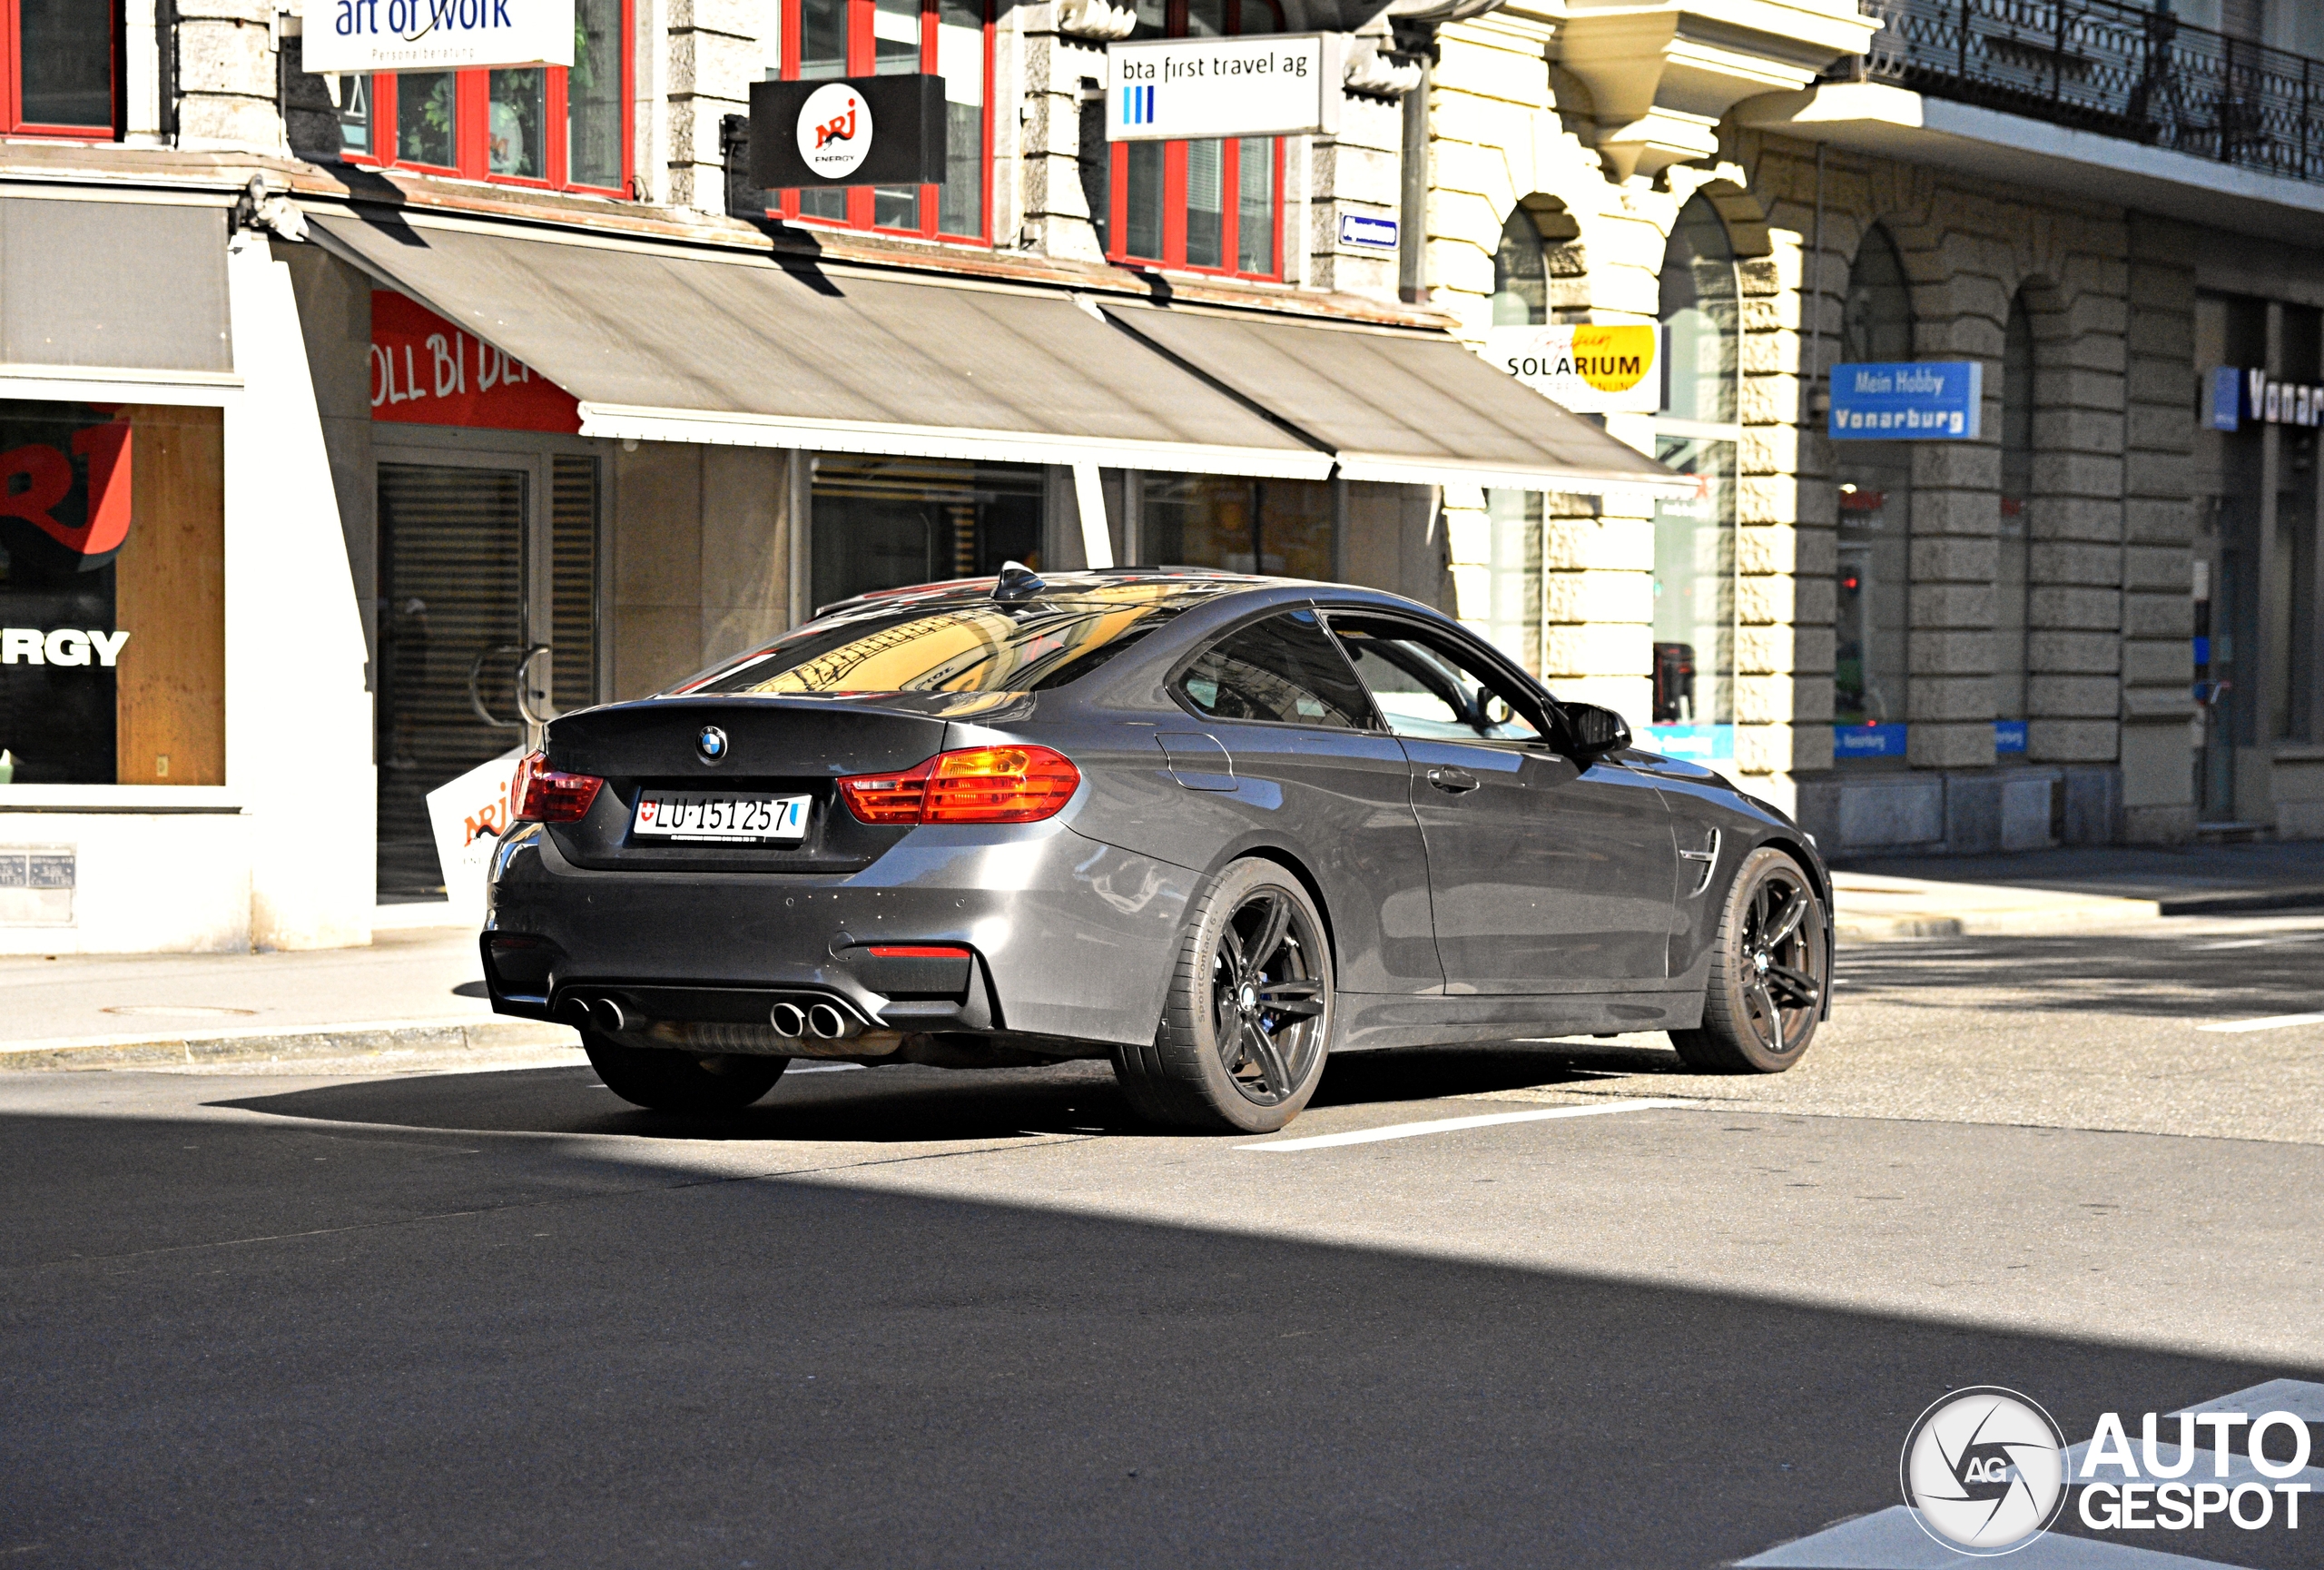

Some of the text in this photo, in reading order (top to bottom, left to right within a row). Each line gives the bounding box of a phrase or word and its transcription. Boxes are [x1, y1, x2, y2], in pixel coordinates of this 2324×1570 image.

[335, 0, 379, 35] art
[429, 0, 512, 31] work
[1123, 52, 1307, 84] bta first travel ag
[426, 331, 466, 398] BI
[1507, 356, 1640, 377] SOLARIUM
[1855, 367, 1945, 397] Mein Hobby
[1835, 409, 1965, 434] Vonarburg
